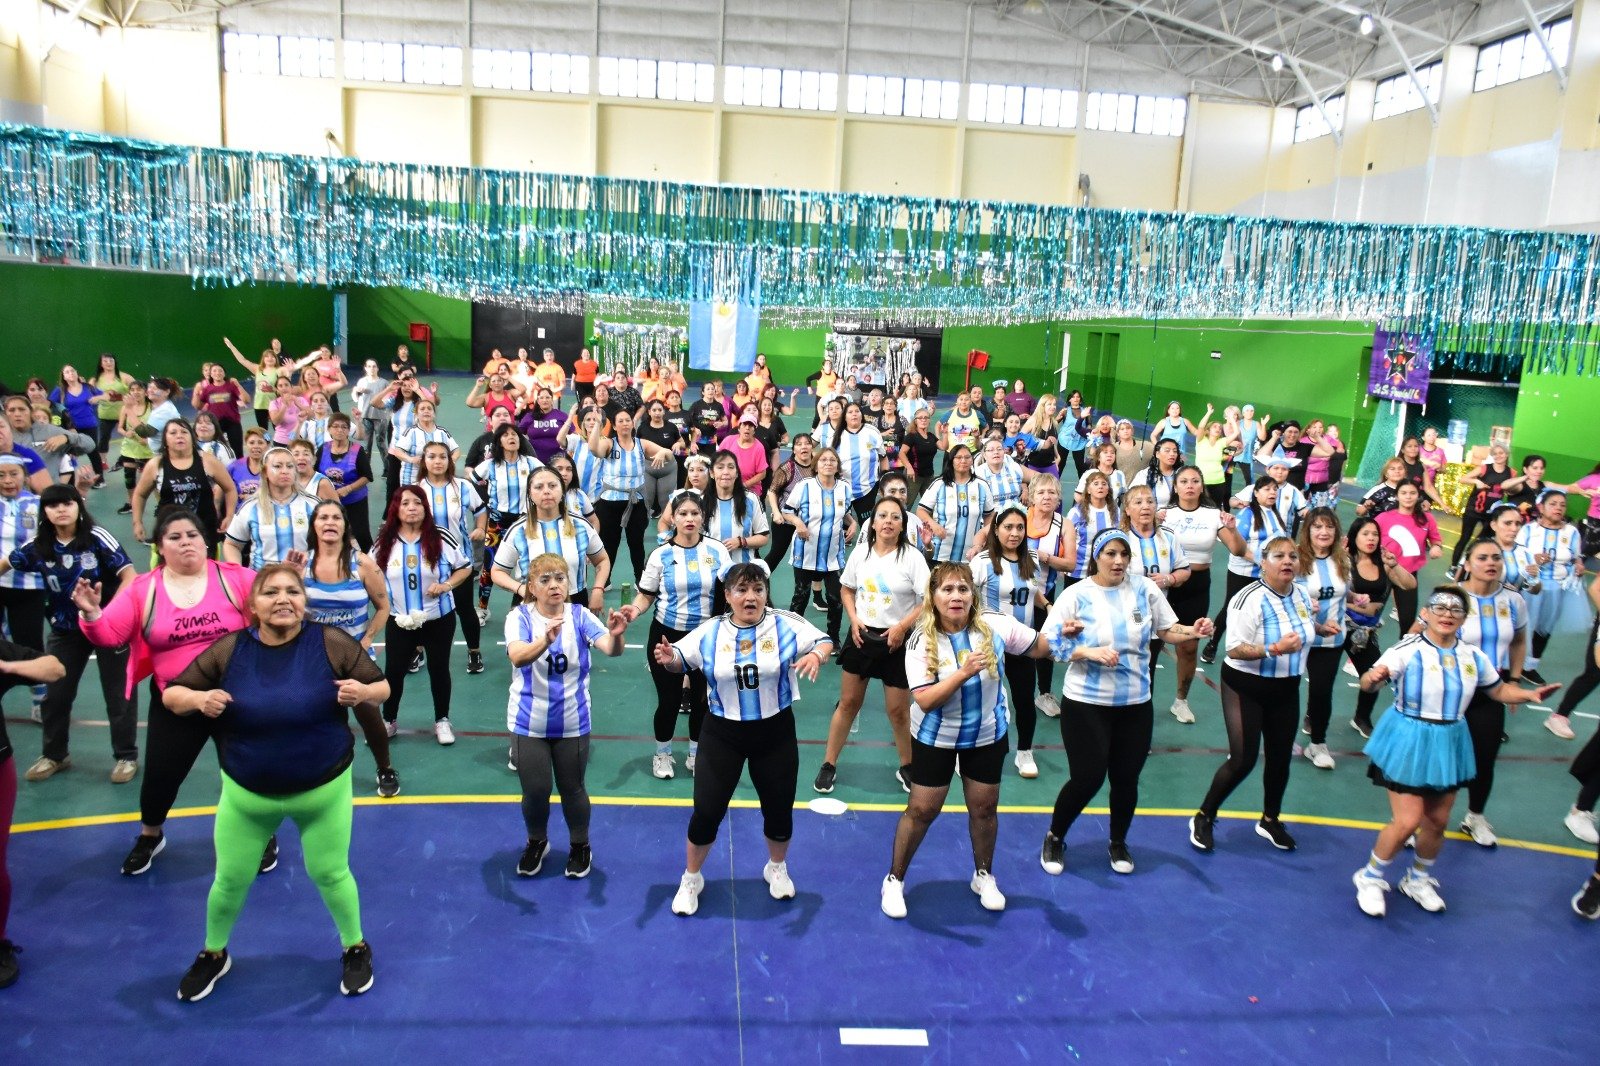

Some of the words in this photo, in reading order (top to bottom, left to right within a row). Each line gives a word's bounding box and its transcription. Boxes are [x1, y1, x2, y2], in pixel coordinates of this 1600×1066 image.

[408, 573, 418, 590] 8
[1009, 587, 1030, 606] 10
[175, 612, 221, 631] ZUMBA
[545, 653, 568, 676] 10
[733, 663, 760, 691] 10
